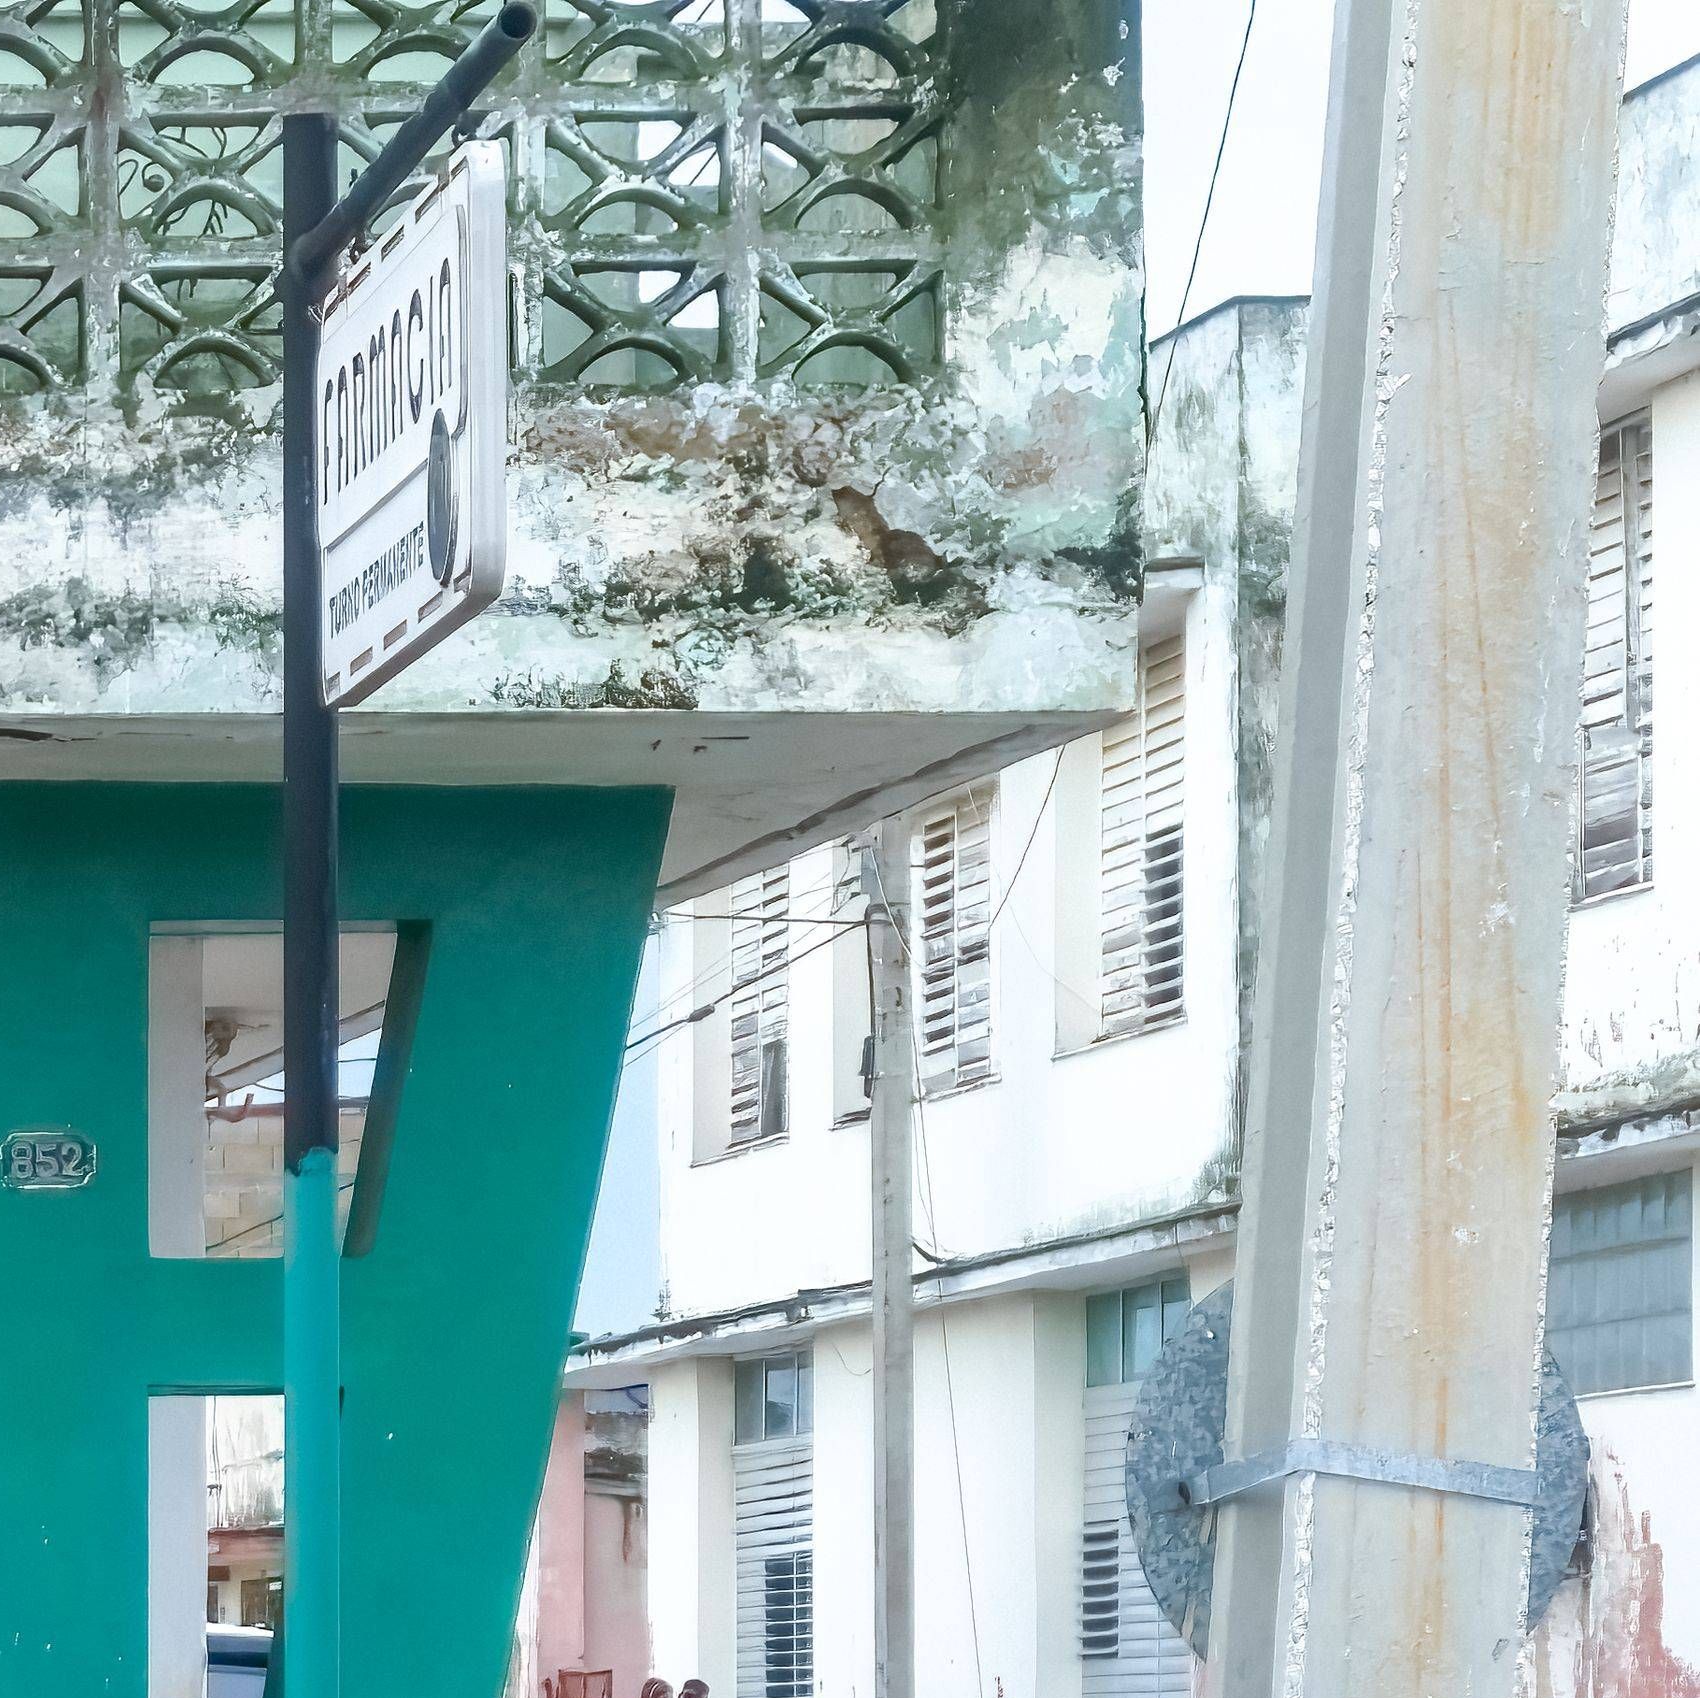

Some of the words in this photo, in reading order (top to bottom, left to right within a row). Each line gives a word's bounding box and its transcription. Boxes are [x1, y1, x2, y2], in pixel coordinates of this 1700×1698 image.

[323, 257, 453, 505] FARMACIA
[329, 576, 361, 640] TURNO
[362, 520, 425, 615] PERMANENTE
[10, 1140, 85, 1179] 852
